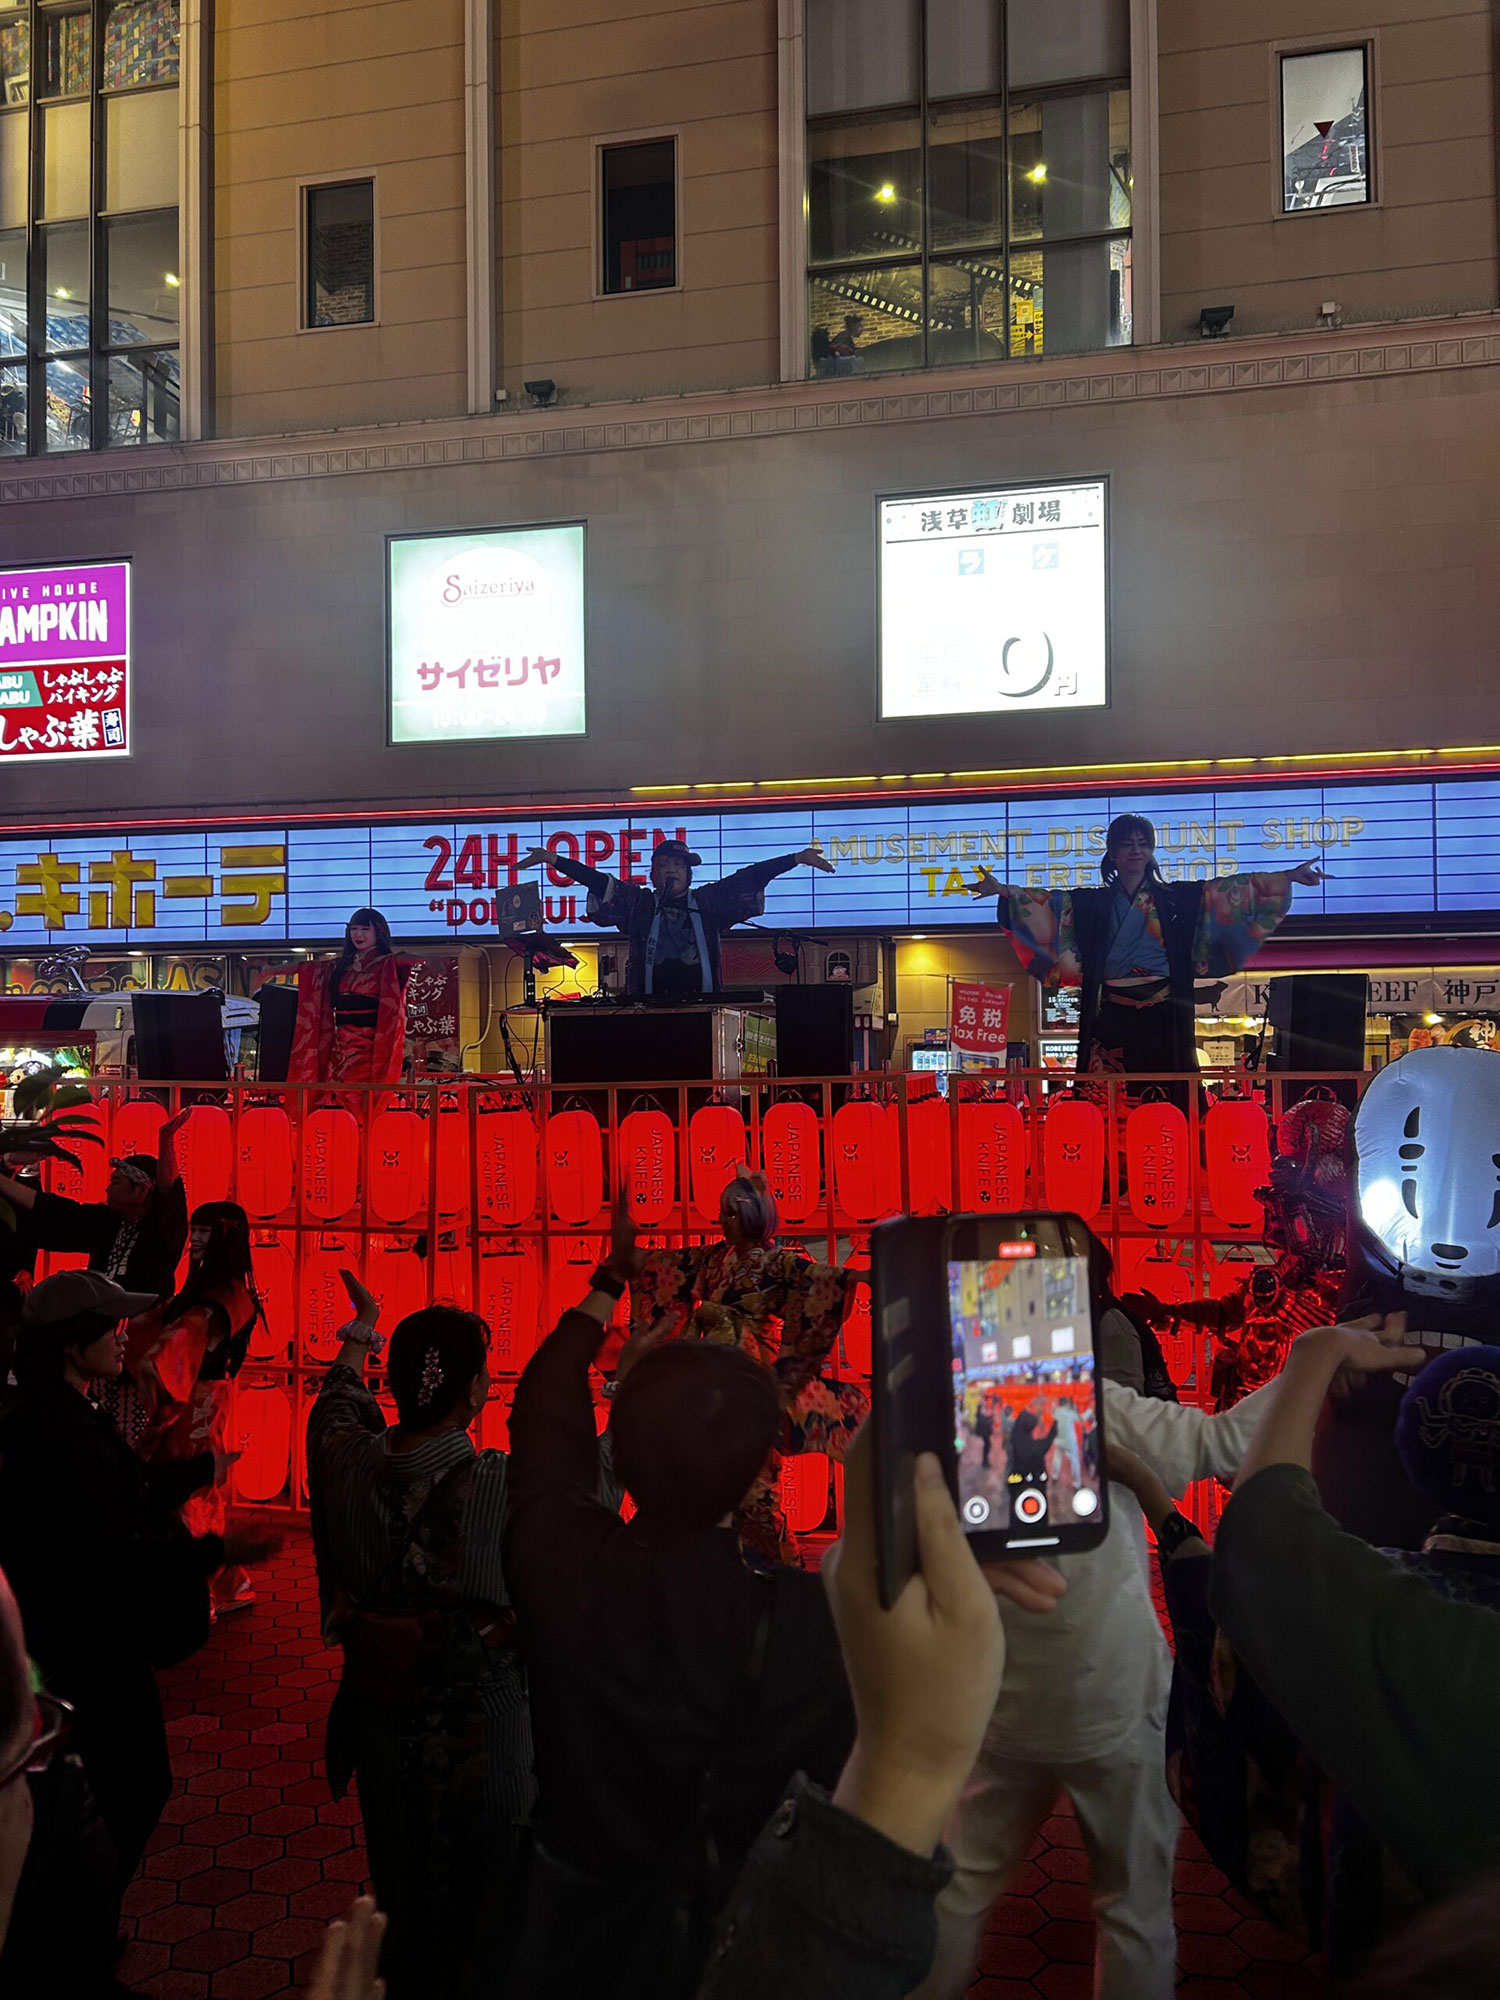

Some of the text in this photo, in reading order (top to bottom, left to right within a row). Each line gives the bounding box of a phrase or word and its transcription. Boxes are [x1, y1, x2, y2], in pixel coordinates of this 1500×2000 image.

[42, 581, 98, 597] HOUSE
[441, 574, 535, 608] Saizeriya
[43, 667, 124, 688] しゃぶしゃぶ
[47, 684, 120, 704] バイキング
[417, 655, 562, 691] サイゼリヤ
[0, 708, 100, 751] しゃぶ葉
[1048, 818, 1245, 858] DISUNT
[1261, 815, 1366, 851] SHOP
[422, 833, 518, 891] 24H
[1025, 861, 1102, 890] FRE
[1160, 857, 1240, 883] HOP
[1367, 980, 1419, 1002] EEF
[1443, 979, 1500, 1005] 神戸
[953, 1024, 974, 1040] Tax
[977, 1028, 1006, 1044] Free
[958, 1004, 1001, 1029] 免税
[314, 1127, 329, 1204] JAPANESE
[492, 1132, 511, 1211] JAPANESE
[636, 1146, 649, 1190] KNIFE
[651, 1127, 665, 1209] JAPANESE
[771, 1140, 785, 1184] KNIFE
[786, 1122, 801, 1203] JAPANESE
[976, 1141, 991, 1187] KNIFE
[994, 1121, 1010, 1206] JAPANESE
[1142, 1144, 1158, 1191] KNIFE
[1160, 1124, 1176, 1210] JAPANESE
[308, 1288, 318, 1328] KNIFE
[321, 1270, 337, 1347] JAPANESE
[497, 1275, 513, 1358] JAPANESE
[782, 1455, 797, 1517] PANESE
